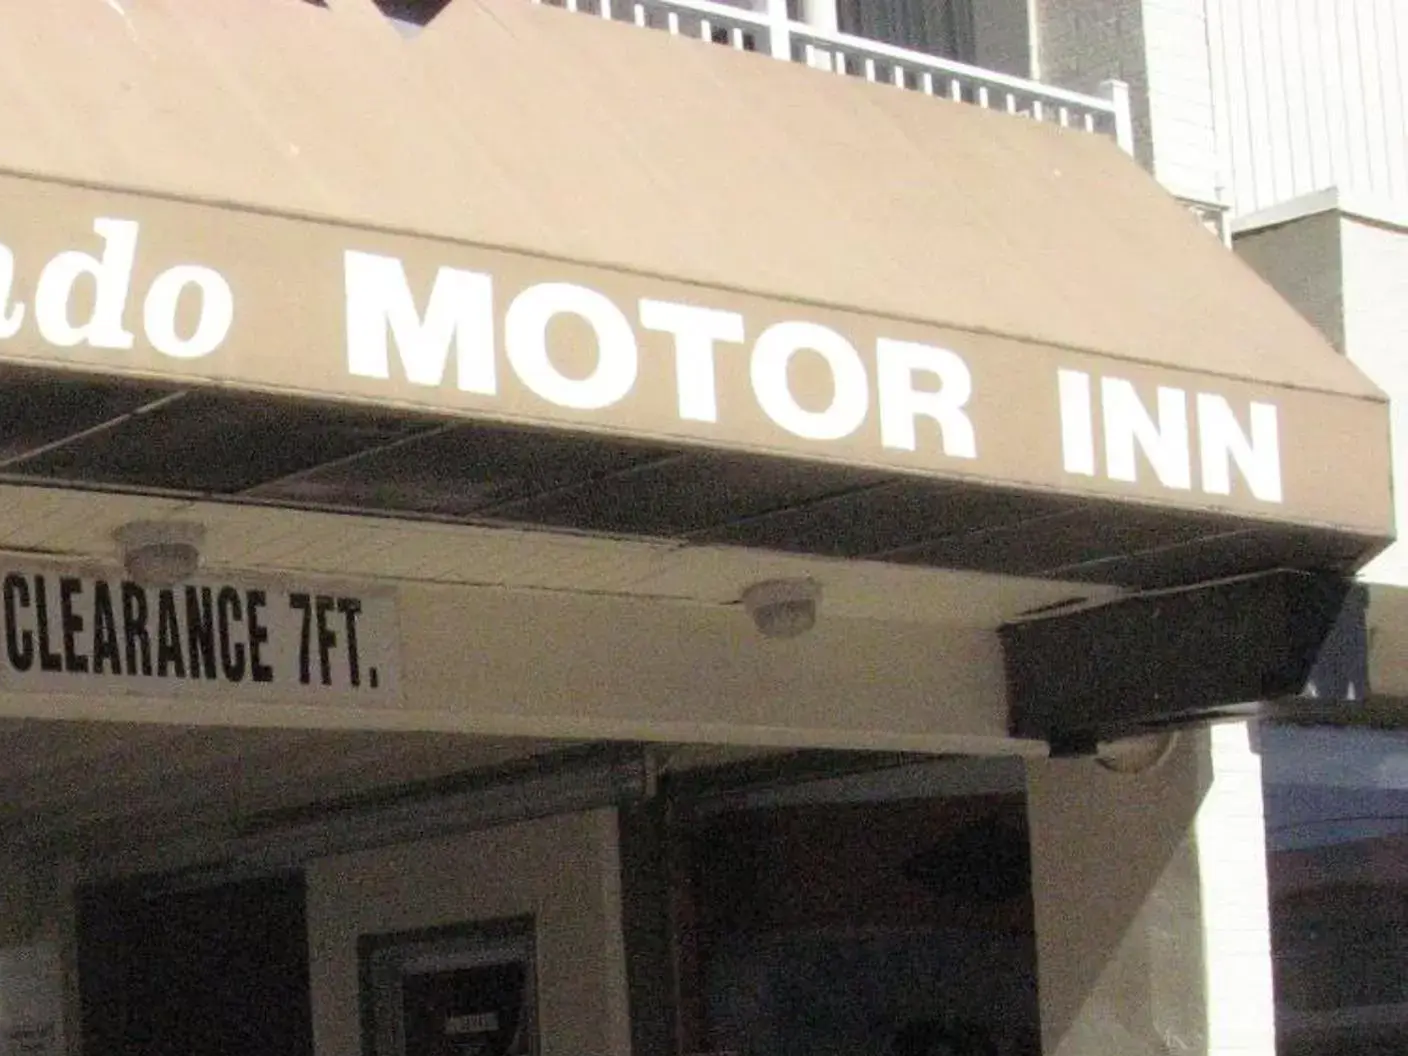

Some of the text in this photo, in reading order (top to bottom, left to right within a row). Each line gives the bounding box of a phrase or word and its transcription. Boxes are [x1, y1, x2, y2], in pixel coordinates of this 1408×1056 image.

[343, 249, 977, 459] MOTOR
[1057, 366, 1283, 504] INN
[2, 571, 379, 688] CLEARANCE 7FT.
